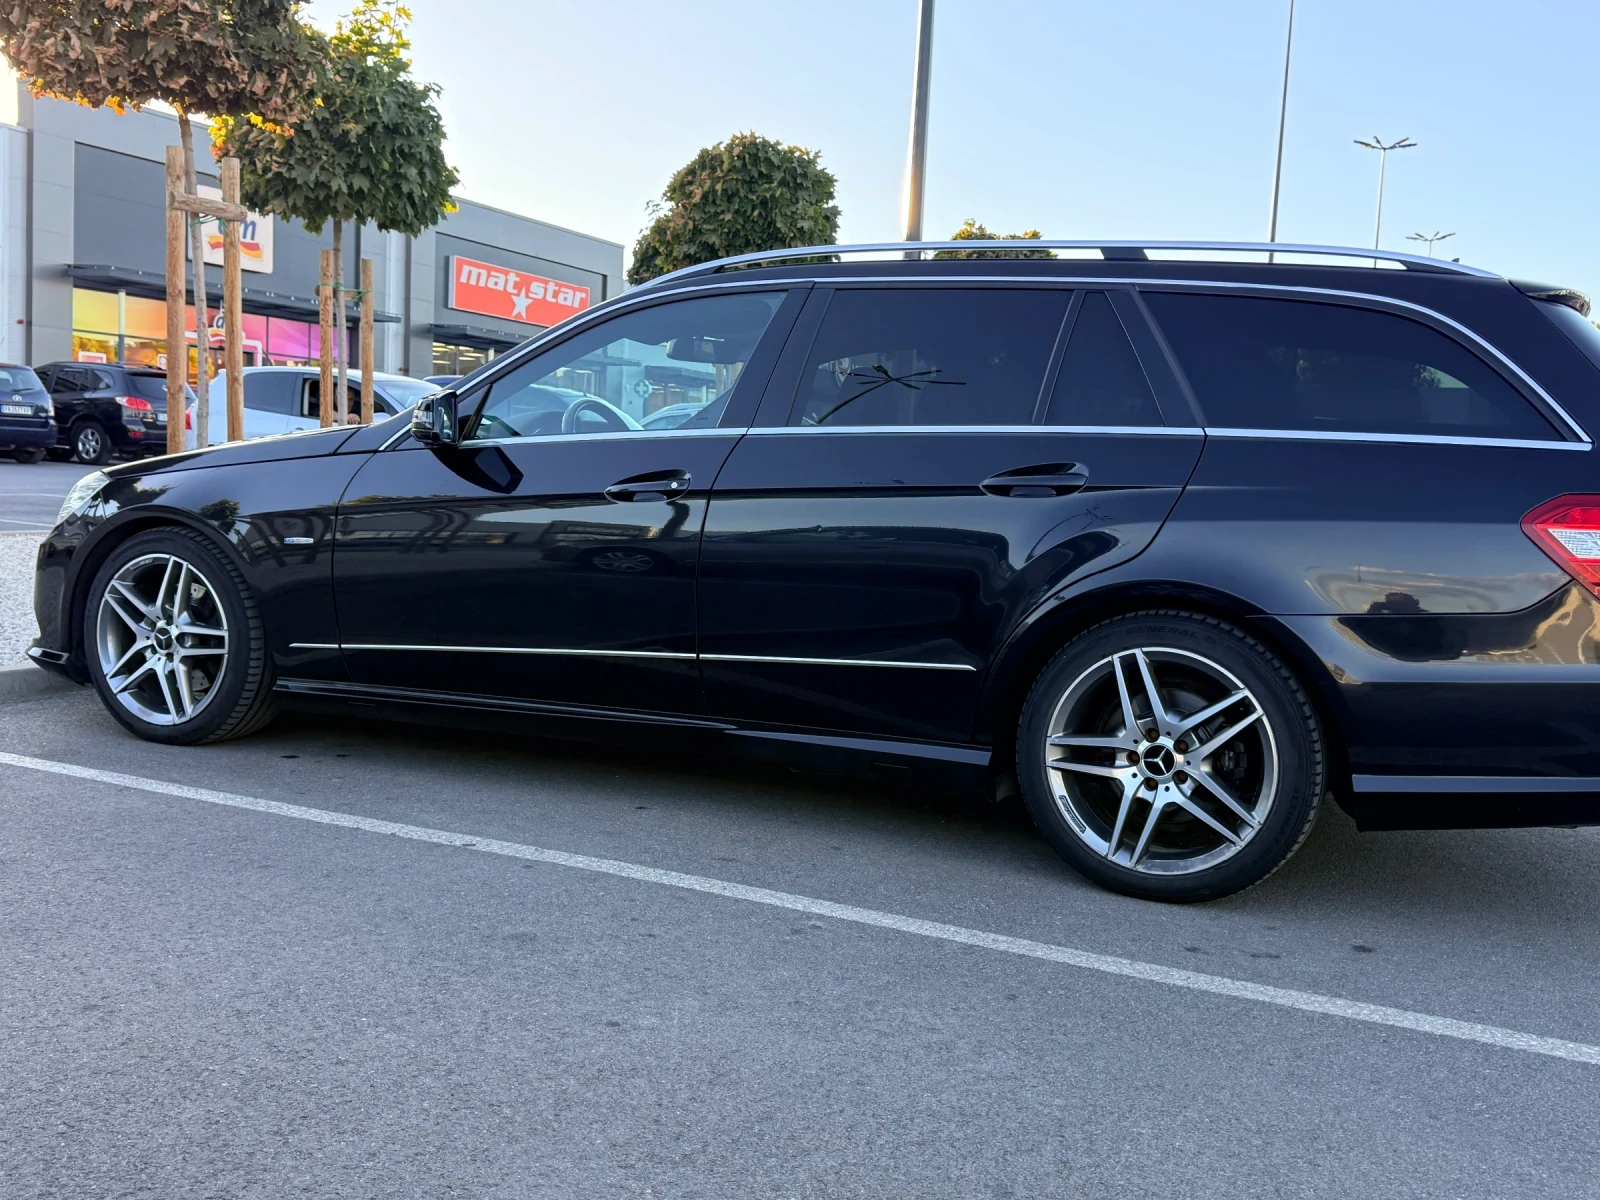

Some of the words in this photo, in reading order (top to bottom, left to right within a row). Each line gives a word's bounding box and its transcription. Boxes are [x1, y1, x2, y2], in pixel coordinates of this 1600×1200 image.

[459, 264, 520, 294] mat
[528, 281, 587, 308] star
[1125, 625, 1200, 640] GENERAL
